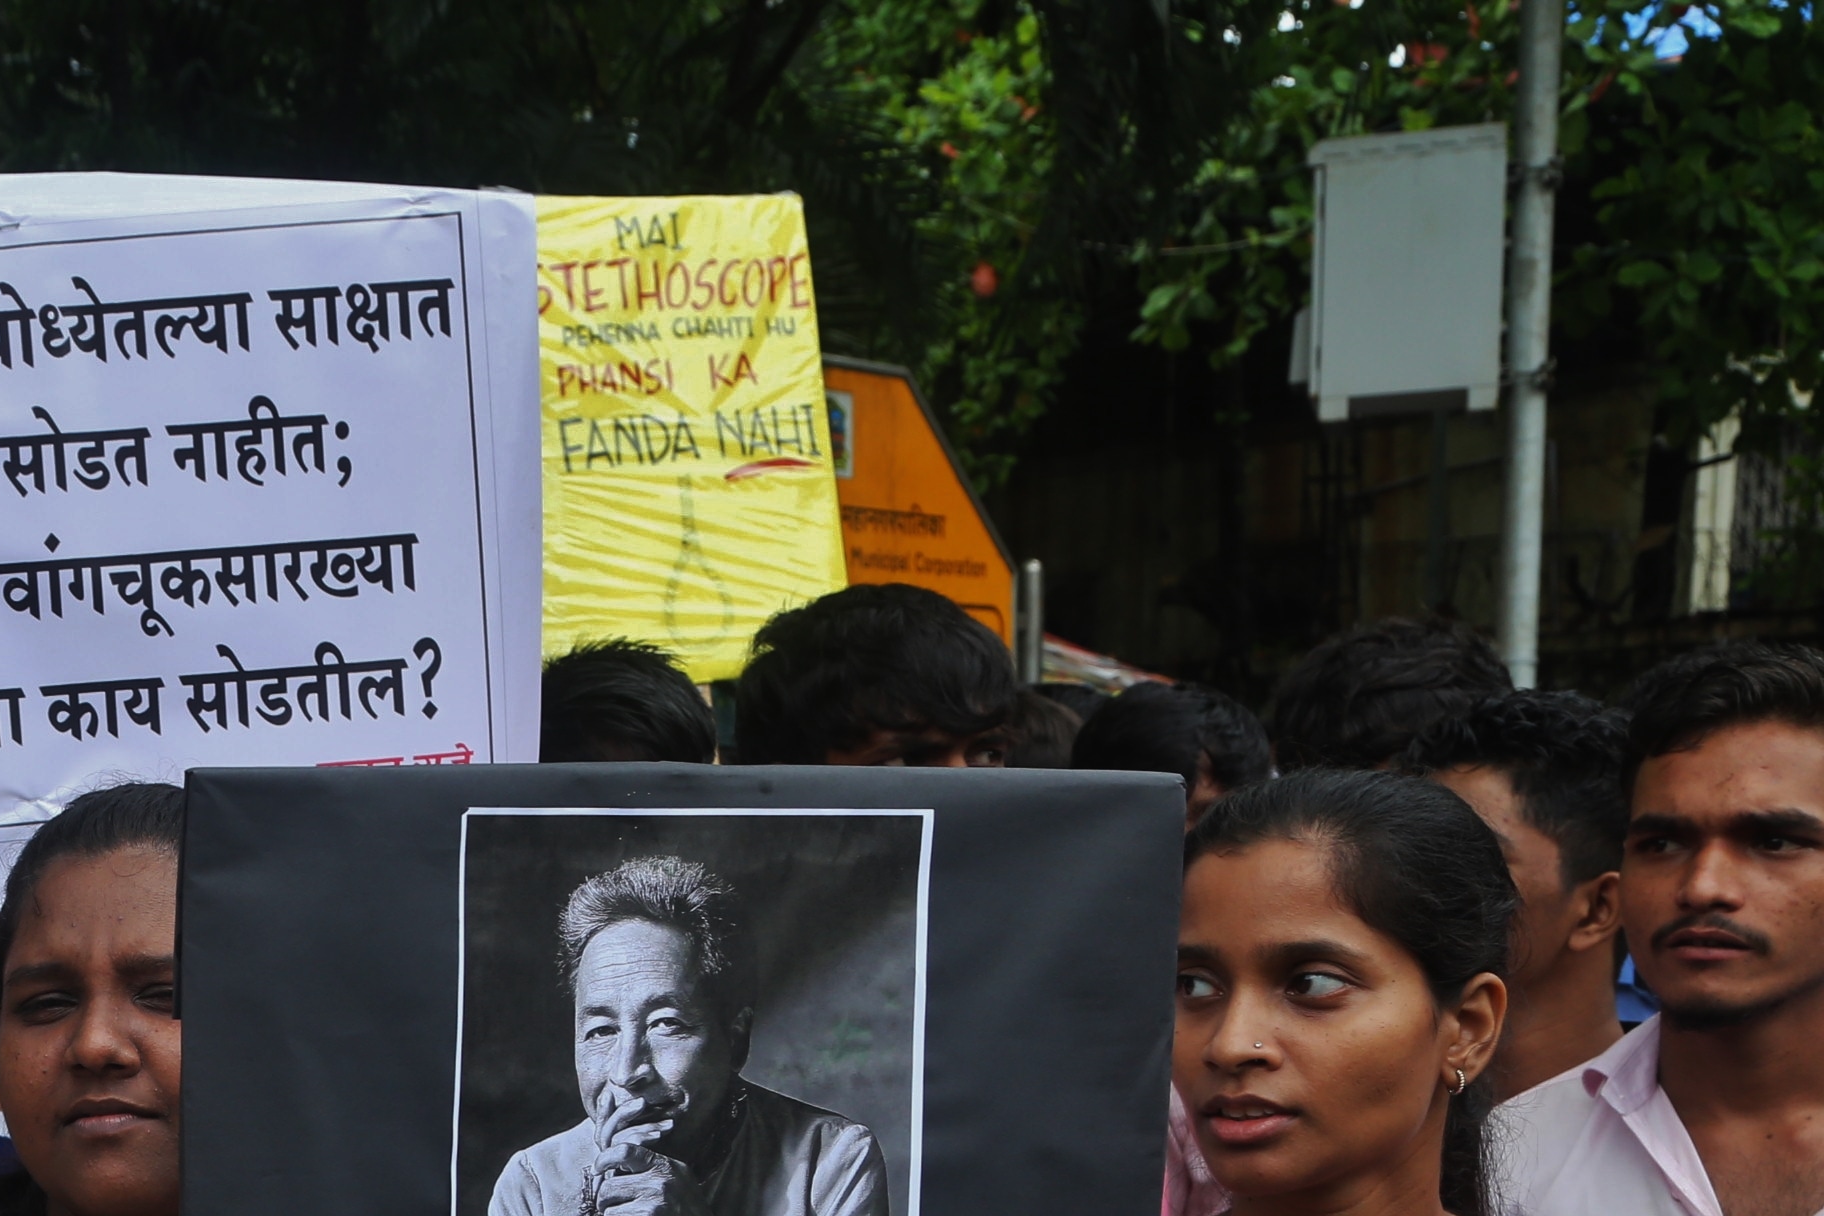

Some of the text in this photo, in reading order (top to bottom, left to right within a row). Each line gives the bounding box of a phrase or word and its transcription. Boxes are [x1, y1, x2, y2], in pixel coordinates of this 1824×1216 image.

[614, 212, 683, 250] MAI
[266, 278, 455, 353] साक्षात
[672, 317, 755, 339] CHAHTI
[766, 317, 796, 336] HU
[557, 353, 758, 397] PHANSI KA
[165, 395, 352, 487] नाहीत;
[559, 404, 821, 473] FANDA NAHI
[39, 677, 165, 741] काय
[179, 637, 442, 733] सोडतील?
